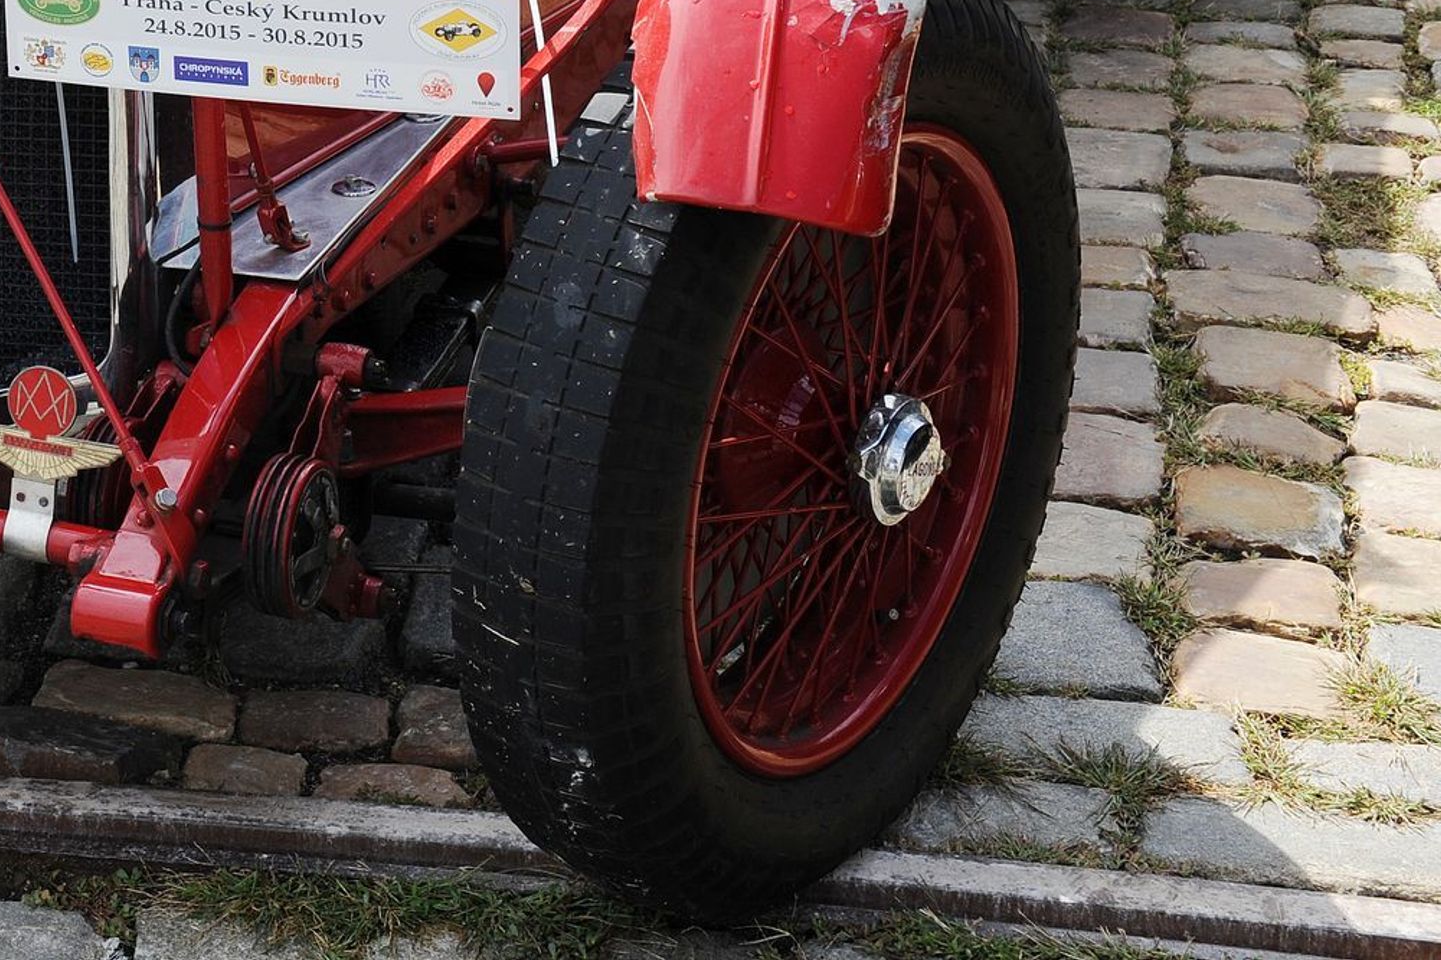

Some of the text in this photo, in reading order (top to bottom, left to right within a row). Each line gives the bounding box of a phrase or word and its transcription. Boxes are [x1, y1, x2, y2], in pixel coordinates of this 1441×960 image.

[283, 4, 387, 26] Krumlov
[144, 18, 241, 40] 24.8.2015
[262, 28, 364, 50] 30.8.2015
[279, 69, 340, 88] Eggenberg
